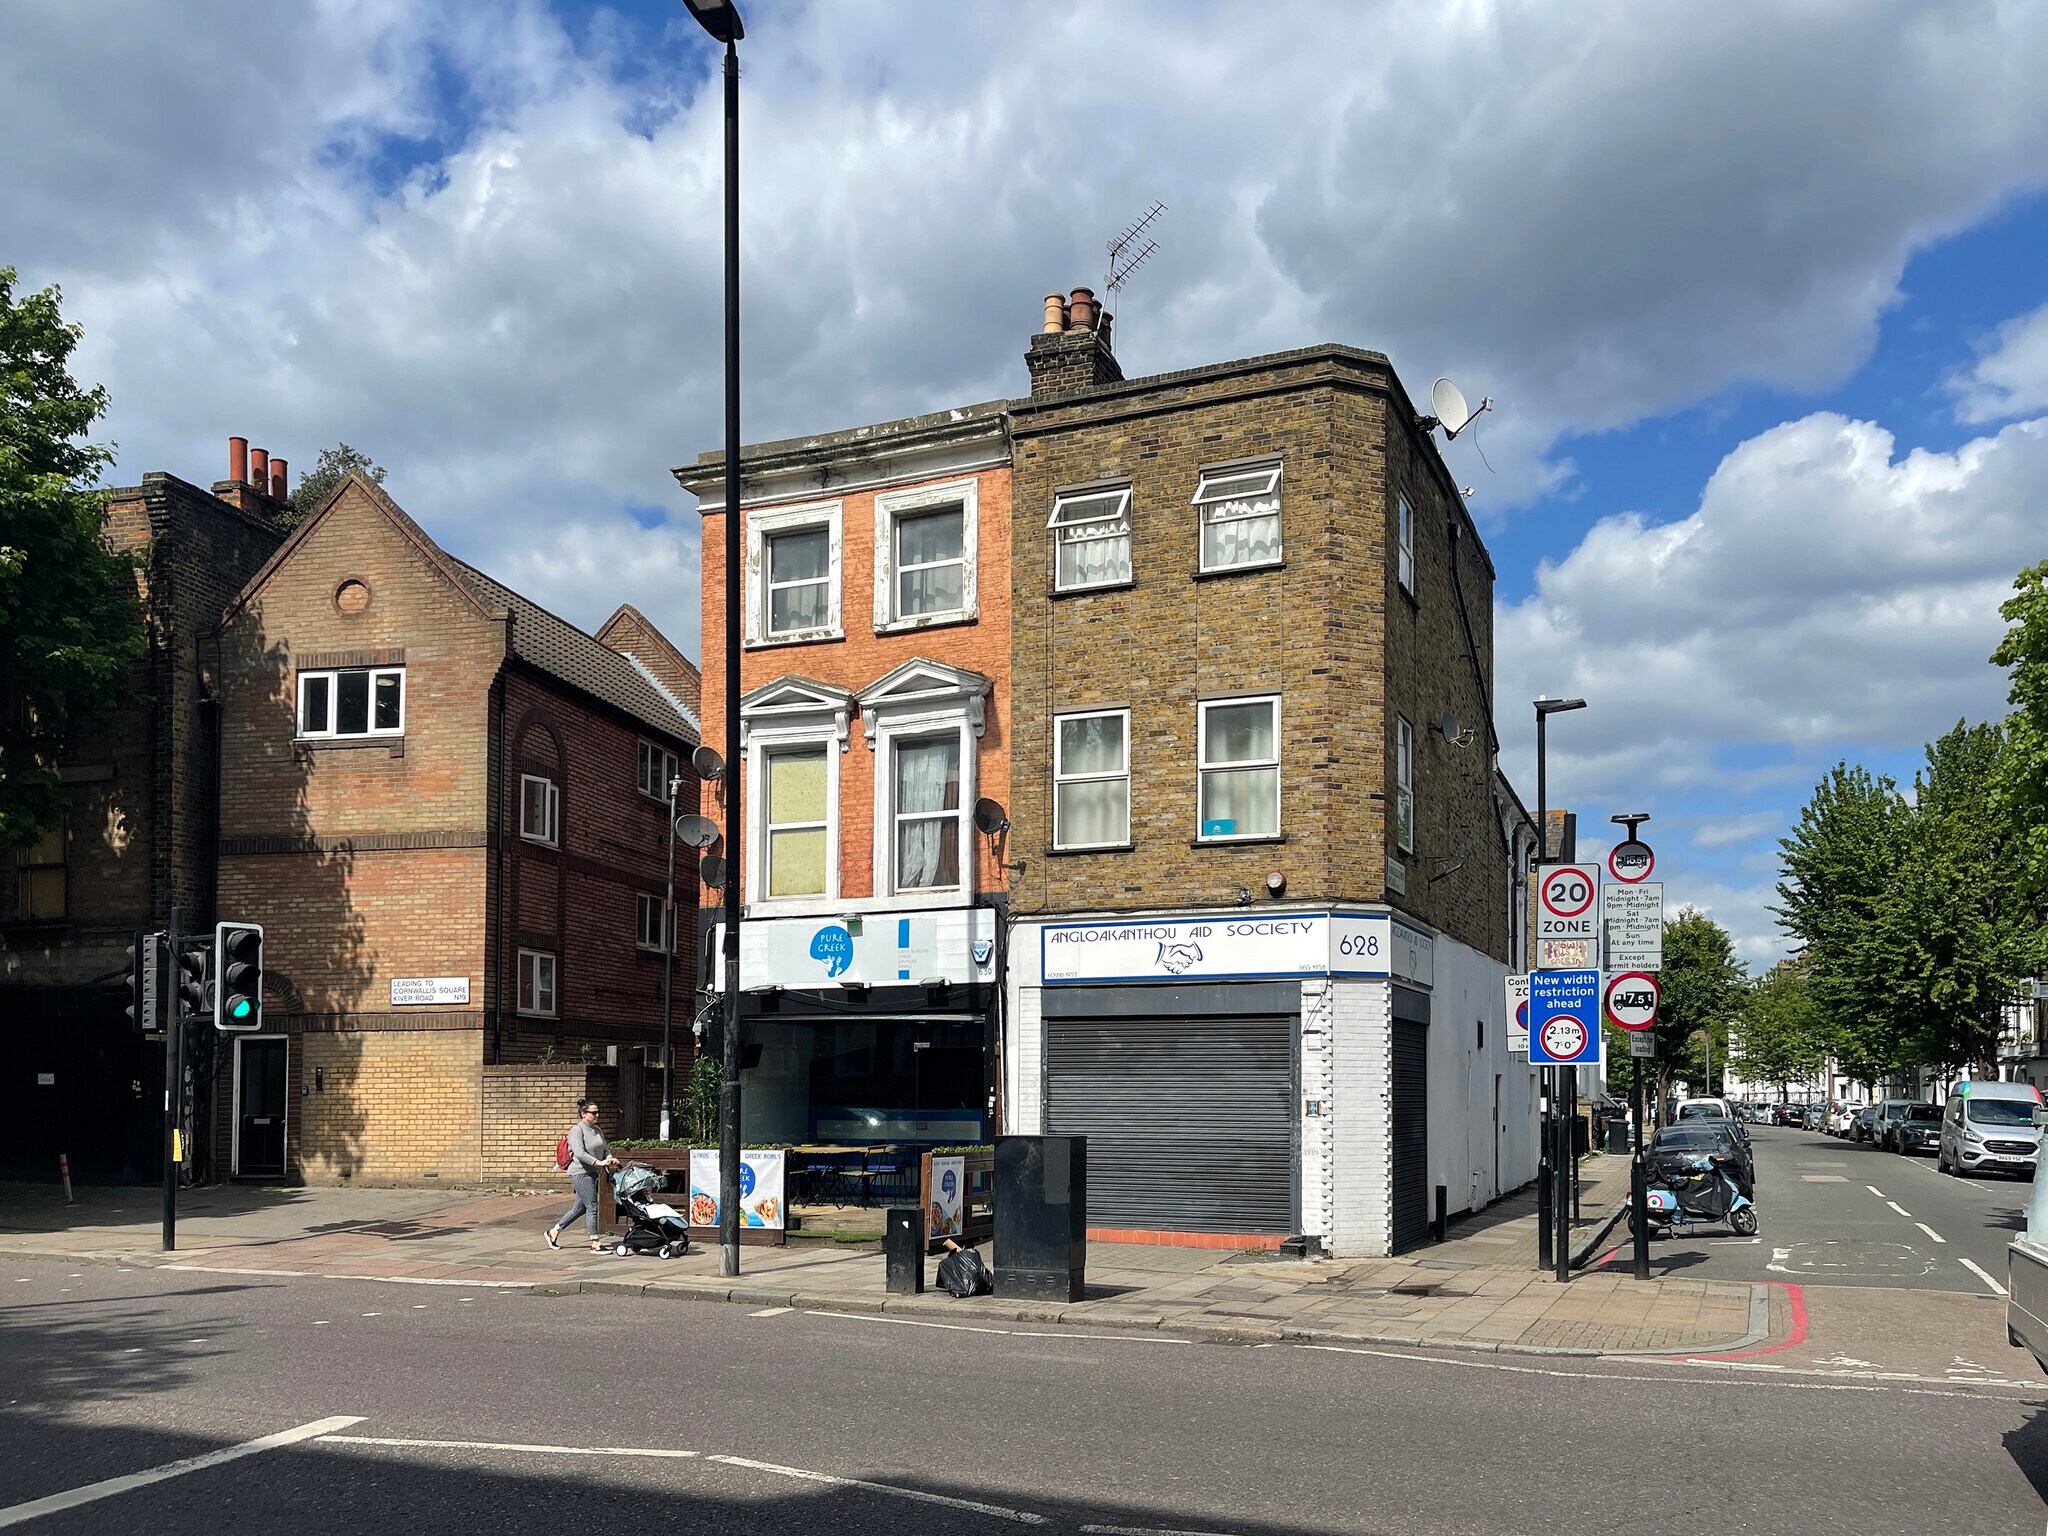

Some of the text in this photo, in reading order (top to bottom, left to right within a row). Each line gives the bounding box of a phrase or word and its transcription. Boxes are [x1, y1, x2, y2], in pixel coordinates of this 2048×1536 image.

[1551, 883, 1586, 902] 20
[1543, 921, 1591, 932] ZONE
[1051, 922, 1313, 943] ANGLOAKANTHOU AID SOCIETY
[820, 934, 843, 942] PURE
[817, 943, 846, 952] GREEK
[1340, 934, 1379, 956] 628
[978, 967, 992, 975] 630
[1534, 975, 1595, 985] New width
[1534, 987, 1595, 997] restriction
[1547, 999, 1582, 1008] ahead
[1626, 993, 1645, 1004] 7.5
